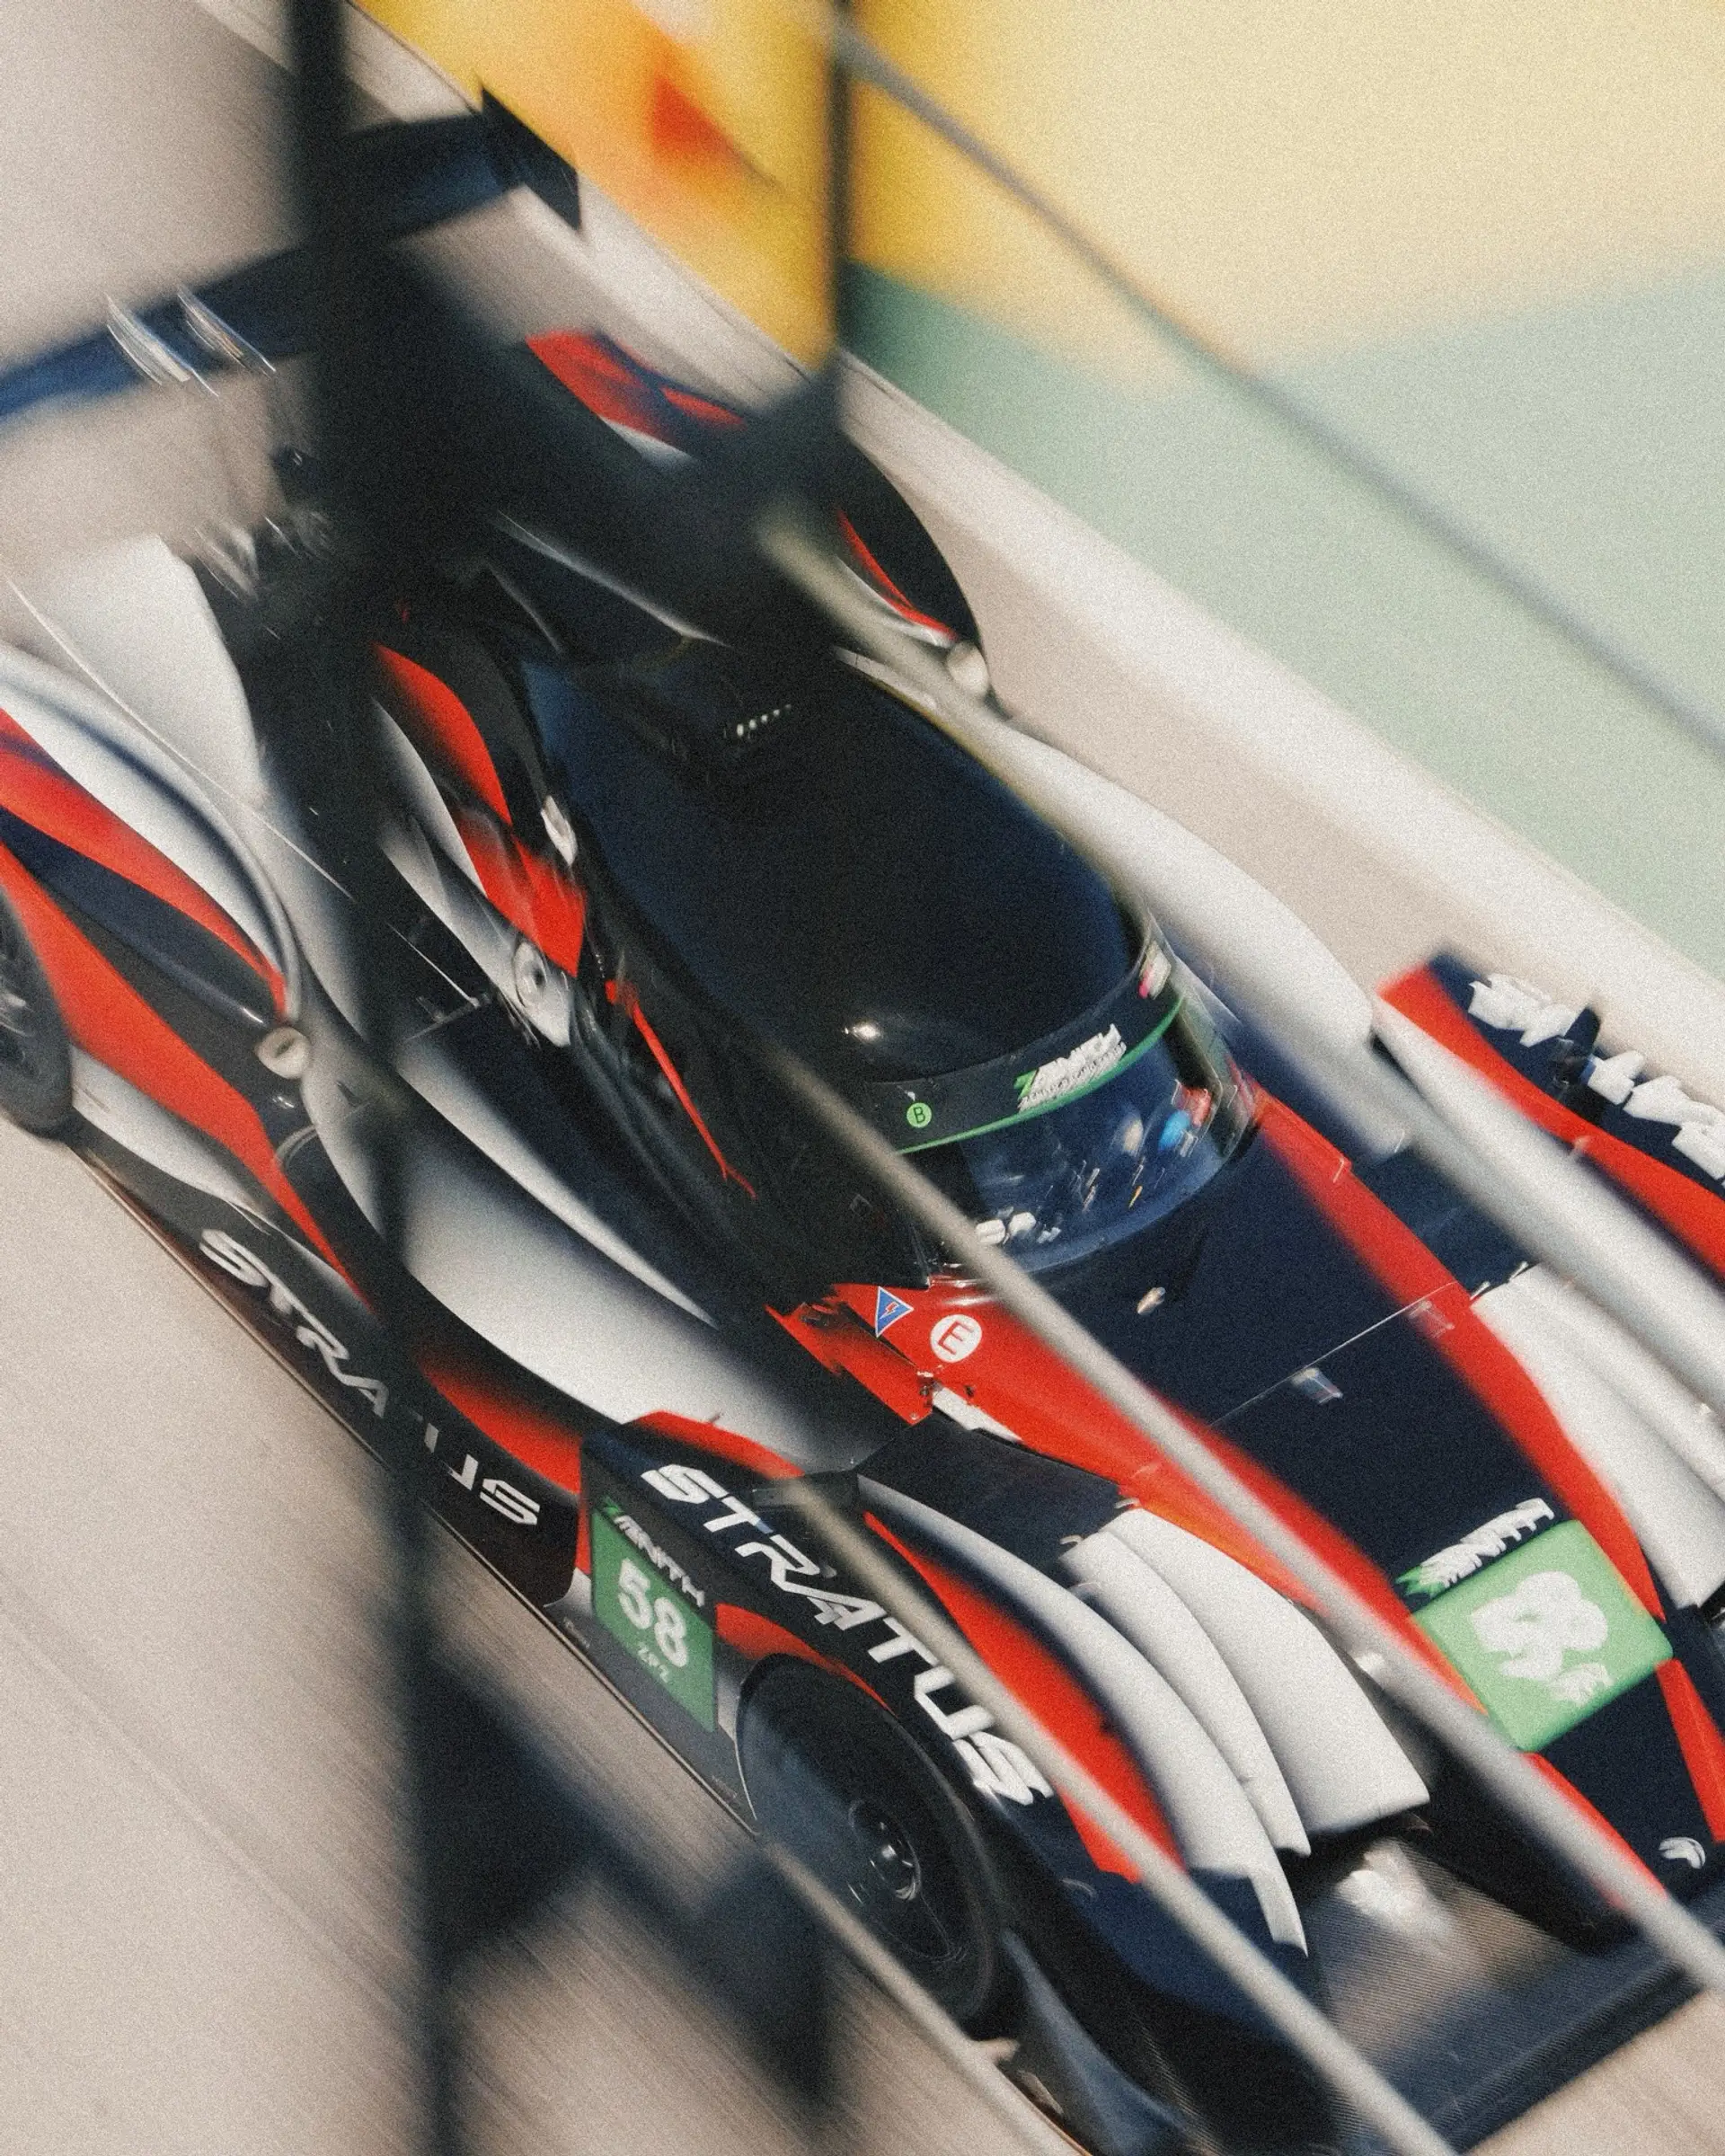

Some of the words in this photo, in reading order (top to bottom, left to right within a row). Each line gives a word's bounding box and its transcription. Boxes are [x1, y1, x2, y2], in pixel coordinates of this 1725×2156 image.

[914, 1107, 926, 1124] B
[937, 1320, 976, 1356] E
[618, 1558, 688, 1668] 58
[641, 1463, 1056, 1807] STRATUS
